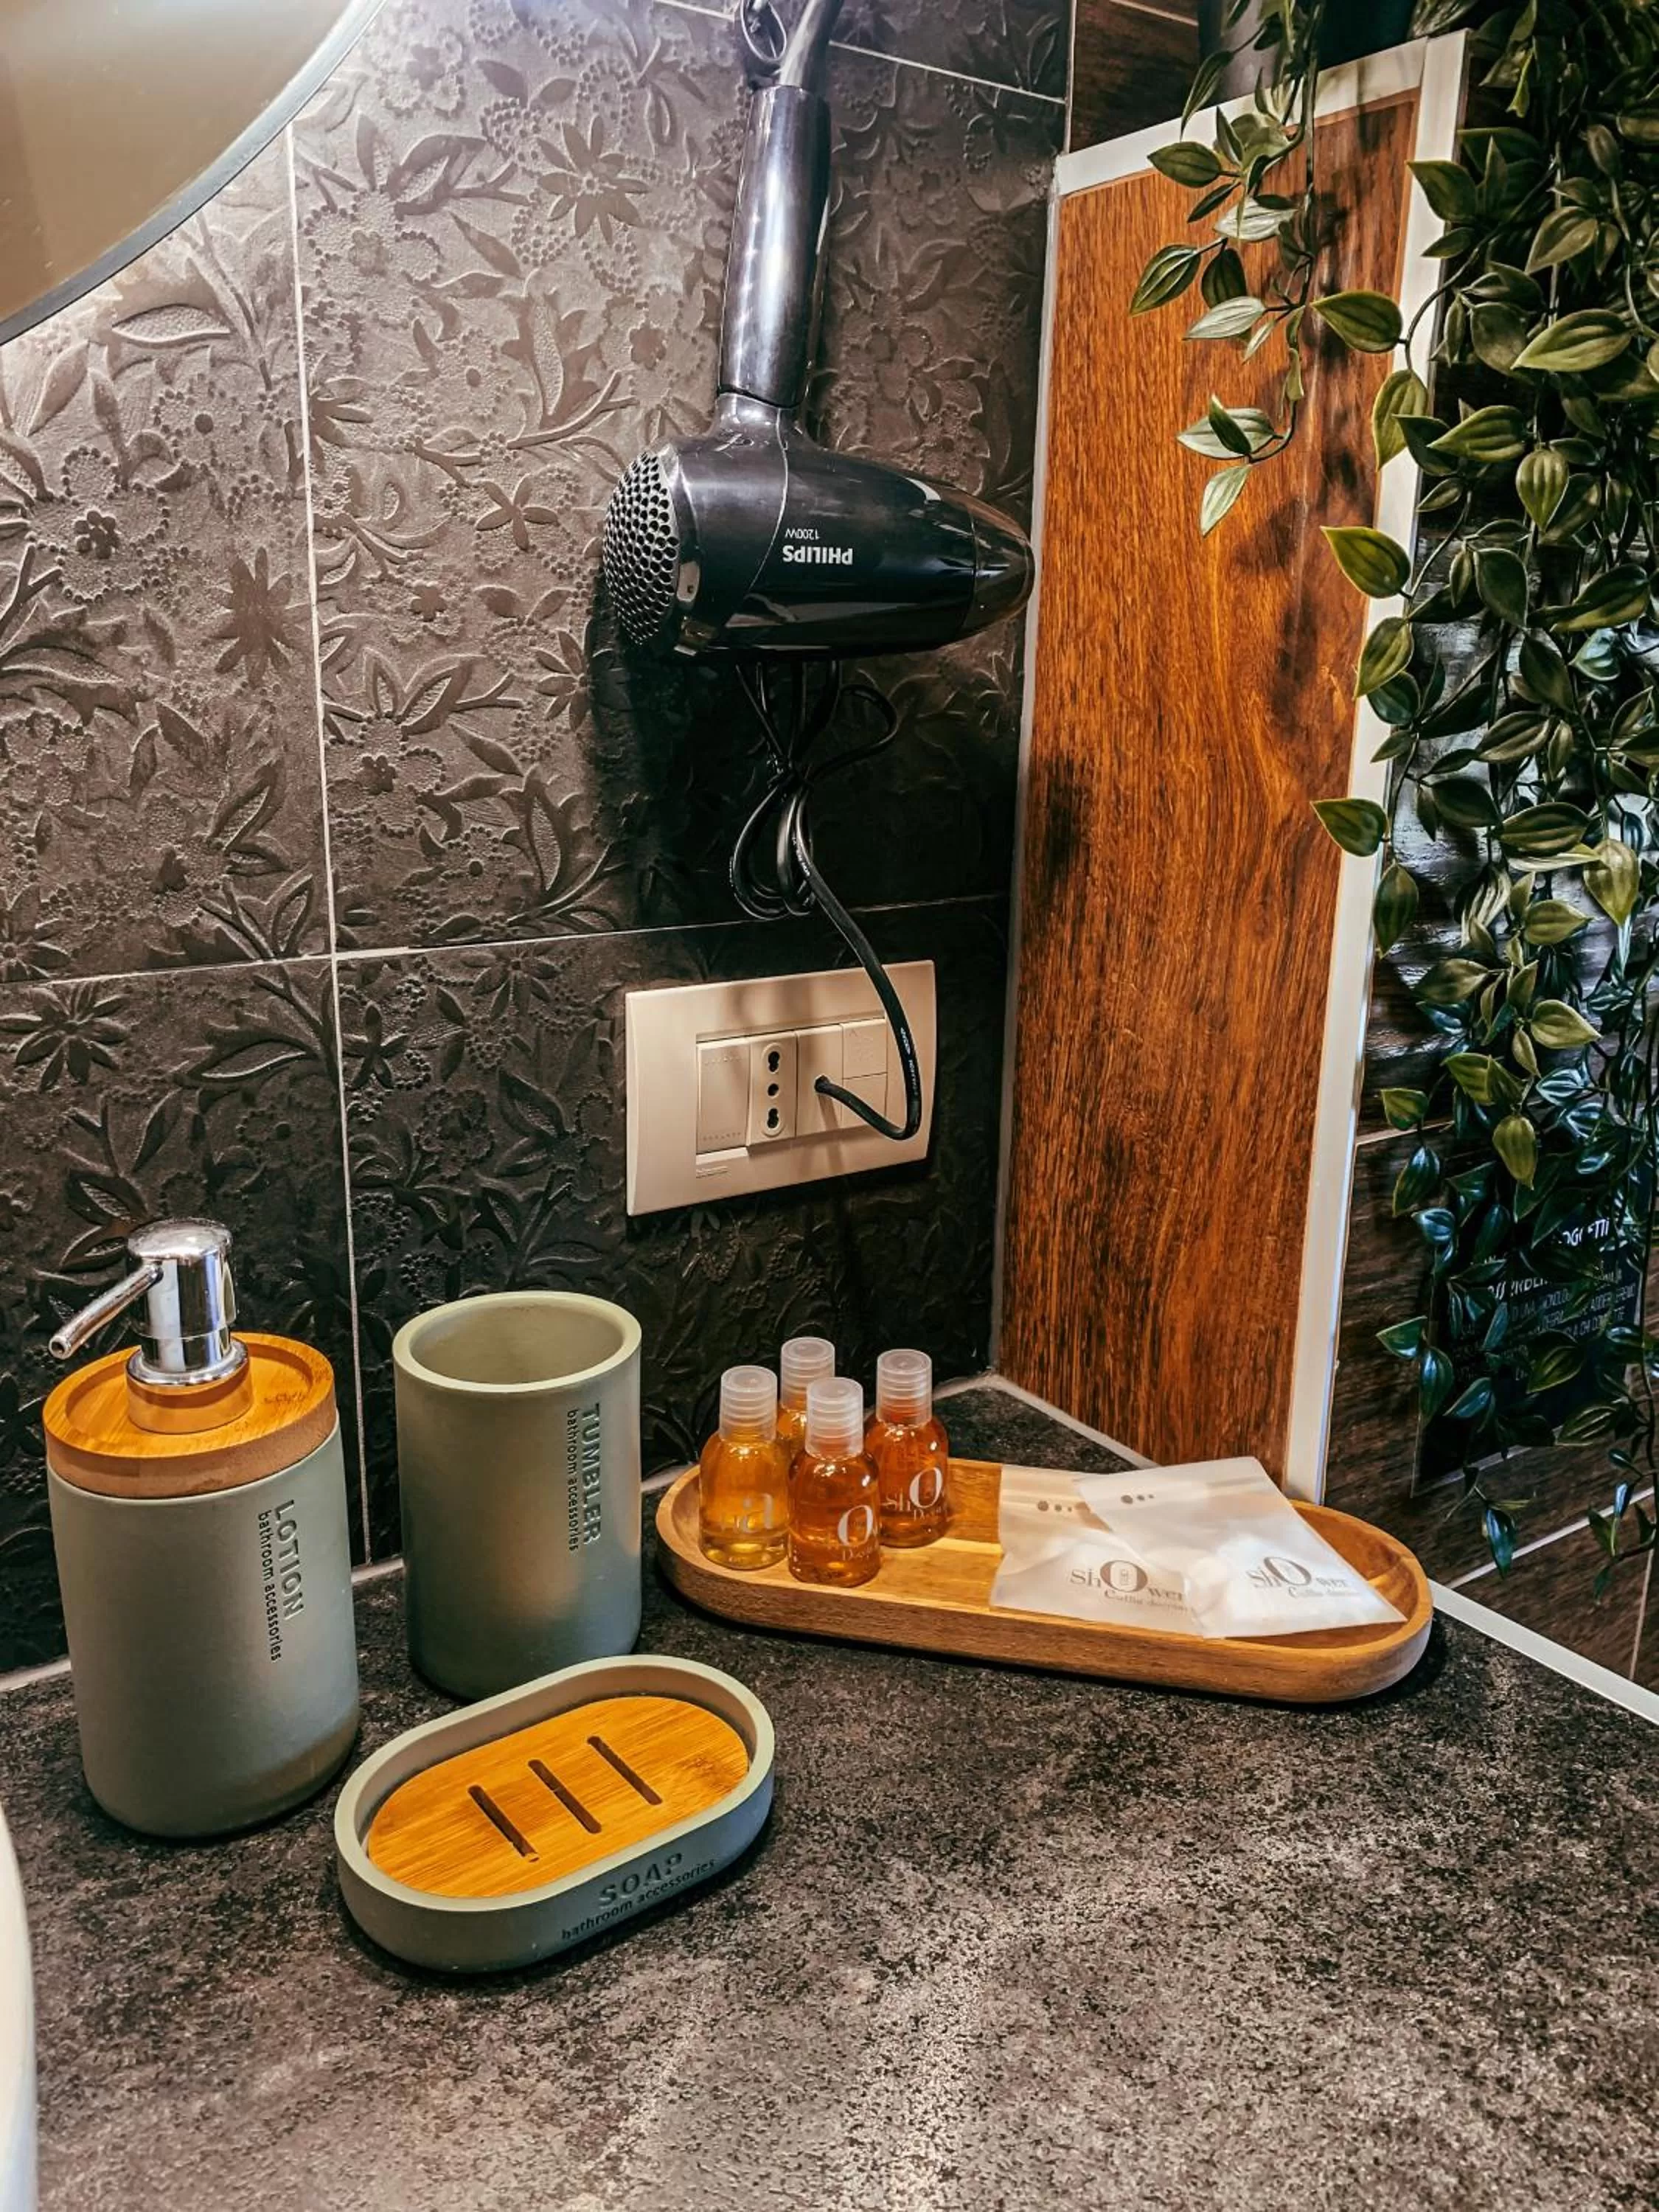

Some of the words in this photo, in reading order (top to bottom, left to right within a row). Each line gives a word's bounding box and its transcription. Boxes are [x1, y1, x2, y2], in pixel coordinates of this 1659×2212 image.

[782, 545, 853, 566] PHILIPS
[785, 528, 820, 540] 1200W
[566, 1408, 580, 1475] bathroom
[582, 1402, 602, 1545] TUMBLER
[258, 1509, 276, 1582] bathroom
[567, 1478, 582, 1552] accessories
[274, 1499, 305, 1621] LOTION
[264, 1583, 284, 1662] accessories
[560, 1900, 633, 1941] bathroom
[637, 1858, 717, 1905] accessories
[598, 1851, 683, 1907] SOAP
